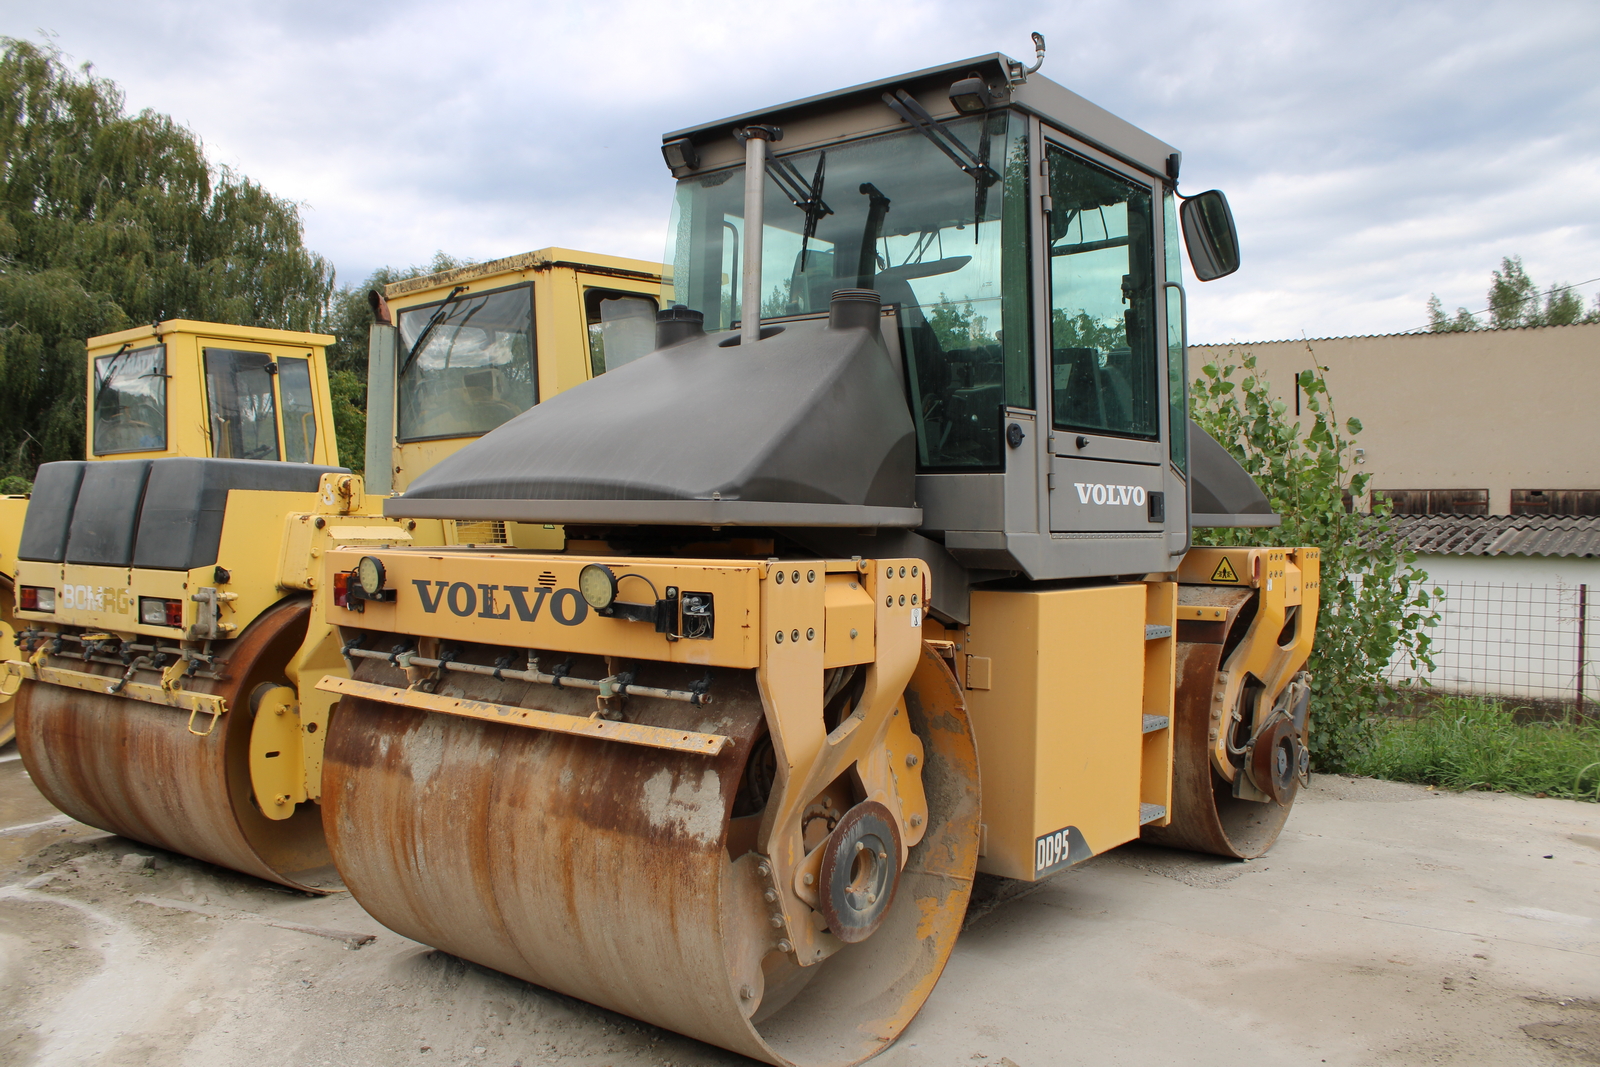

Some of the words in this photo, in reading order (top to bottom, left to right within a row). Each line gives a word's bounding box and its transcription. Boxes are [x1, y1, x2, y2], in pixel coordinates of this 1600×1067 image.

[1073, 482, 1146, 507] VOLVO
[63, 584, 129, 615] BOMAG
[411, 579, 589, 626] VOLVO
[1037, 829, 1069, 871] DD95
